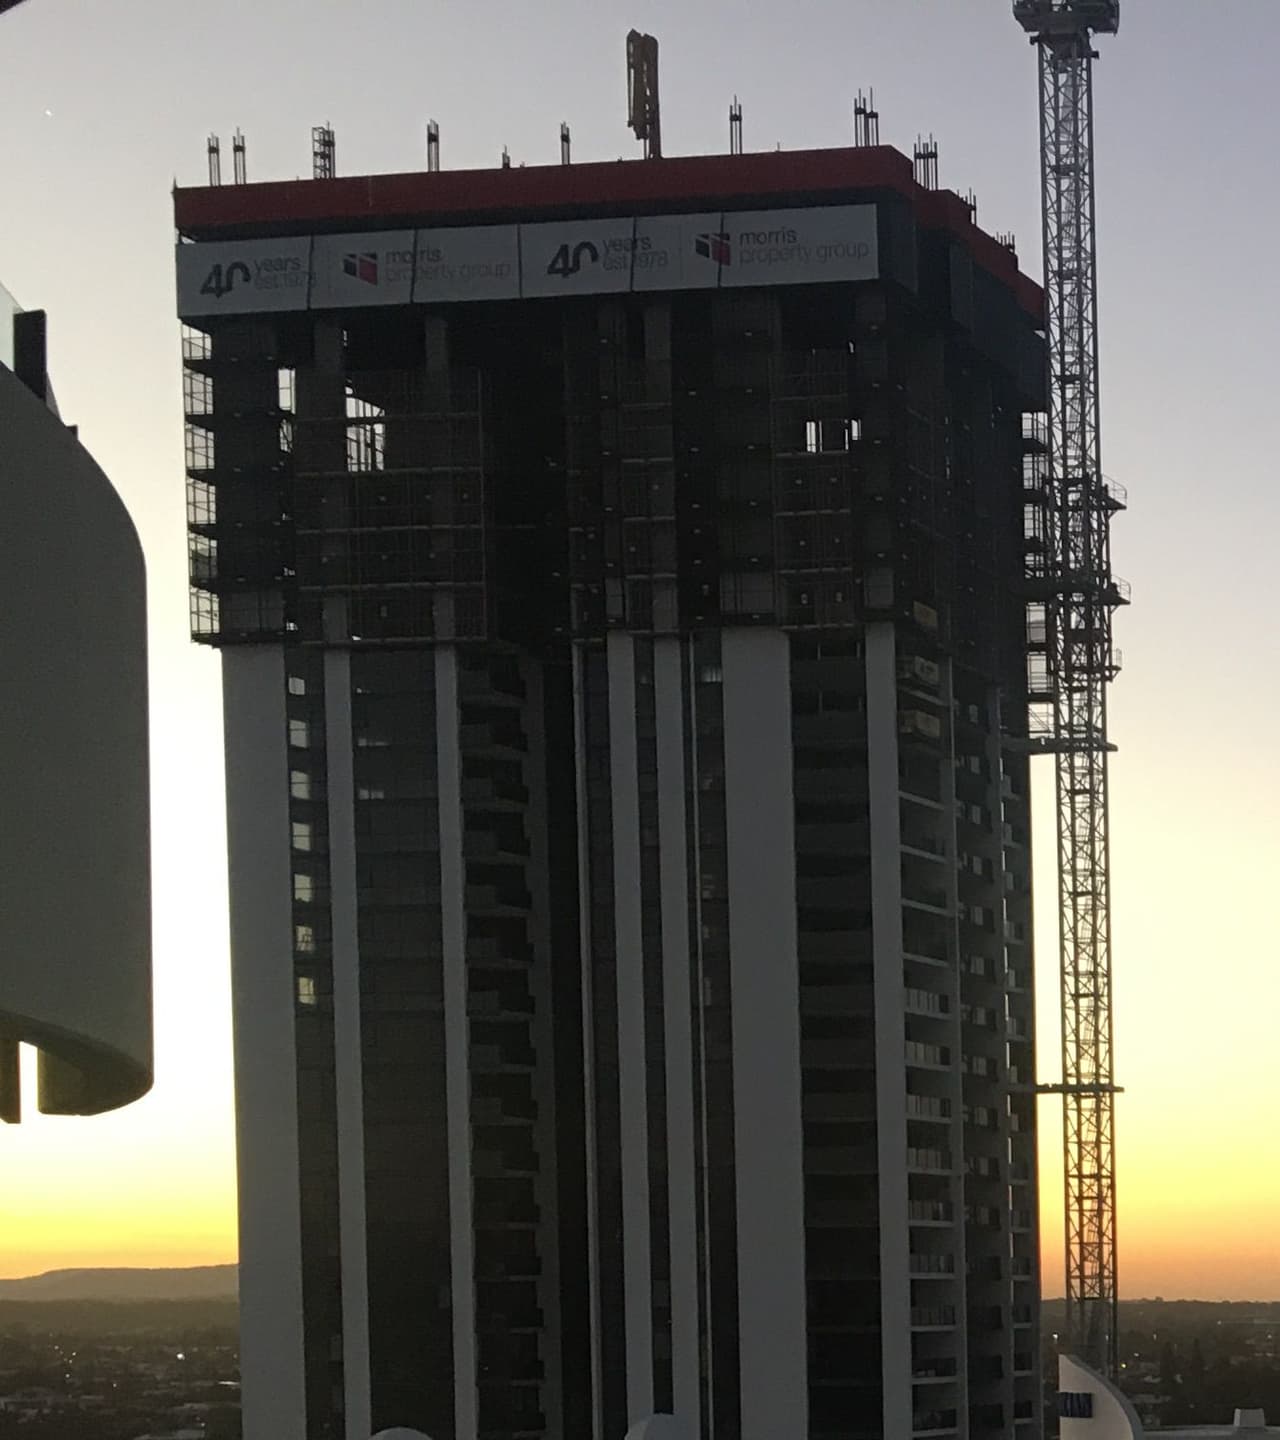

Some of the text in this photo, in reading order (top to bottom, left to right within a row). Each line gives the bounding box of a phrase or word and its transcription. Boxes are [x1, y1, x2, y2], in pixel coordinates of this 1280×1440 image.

[602, 236, 652, 257] years
[739, 226, 799, 246] morris
[386, 247, 442, 264] moris
[546, 241, 599, 279] 40
[739, 239, 871, 269] property group
[254, 256, 302, 276] years
[385, 260, 512, 285] proerty group
[200, 261, 251, 298] 40
